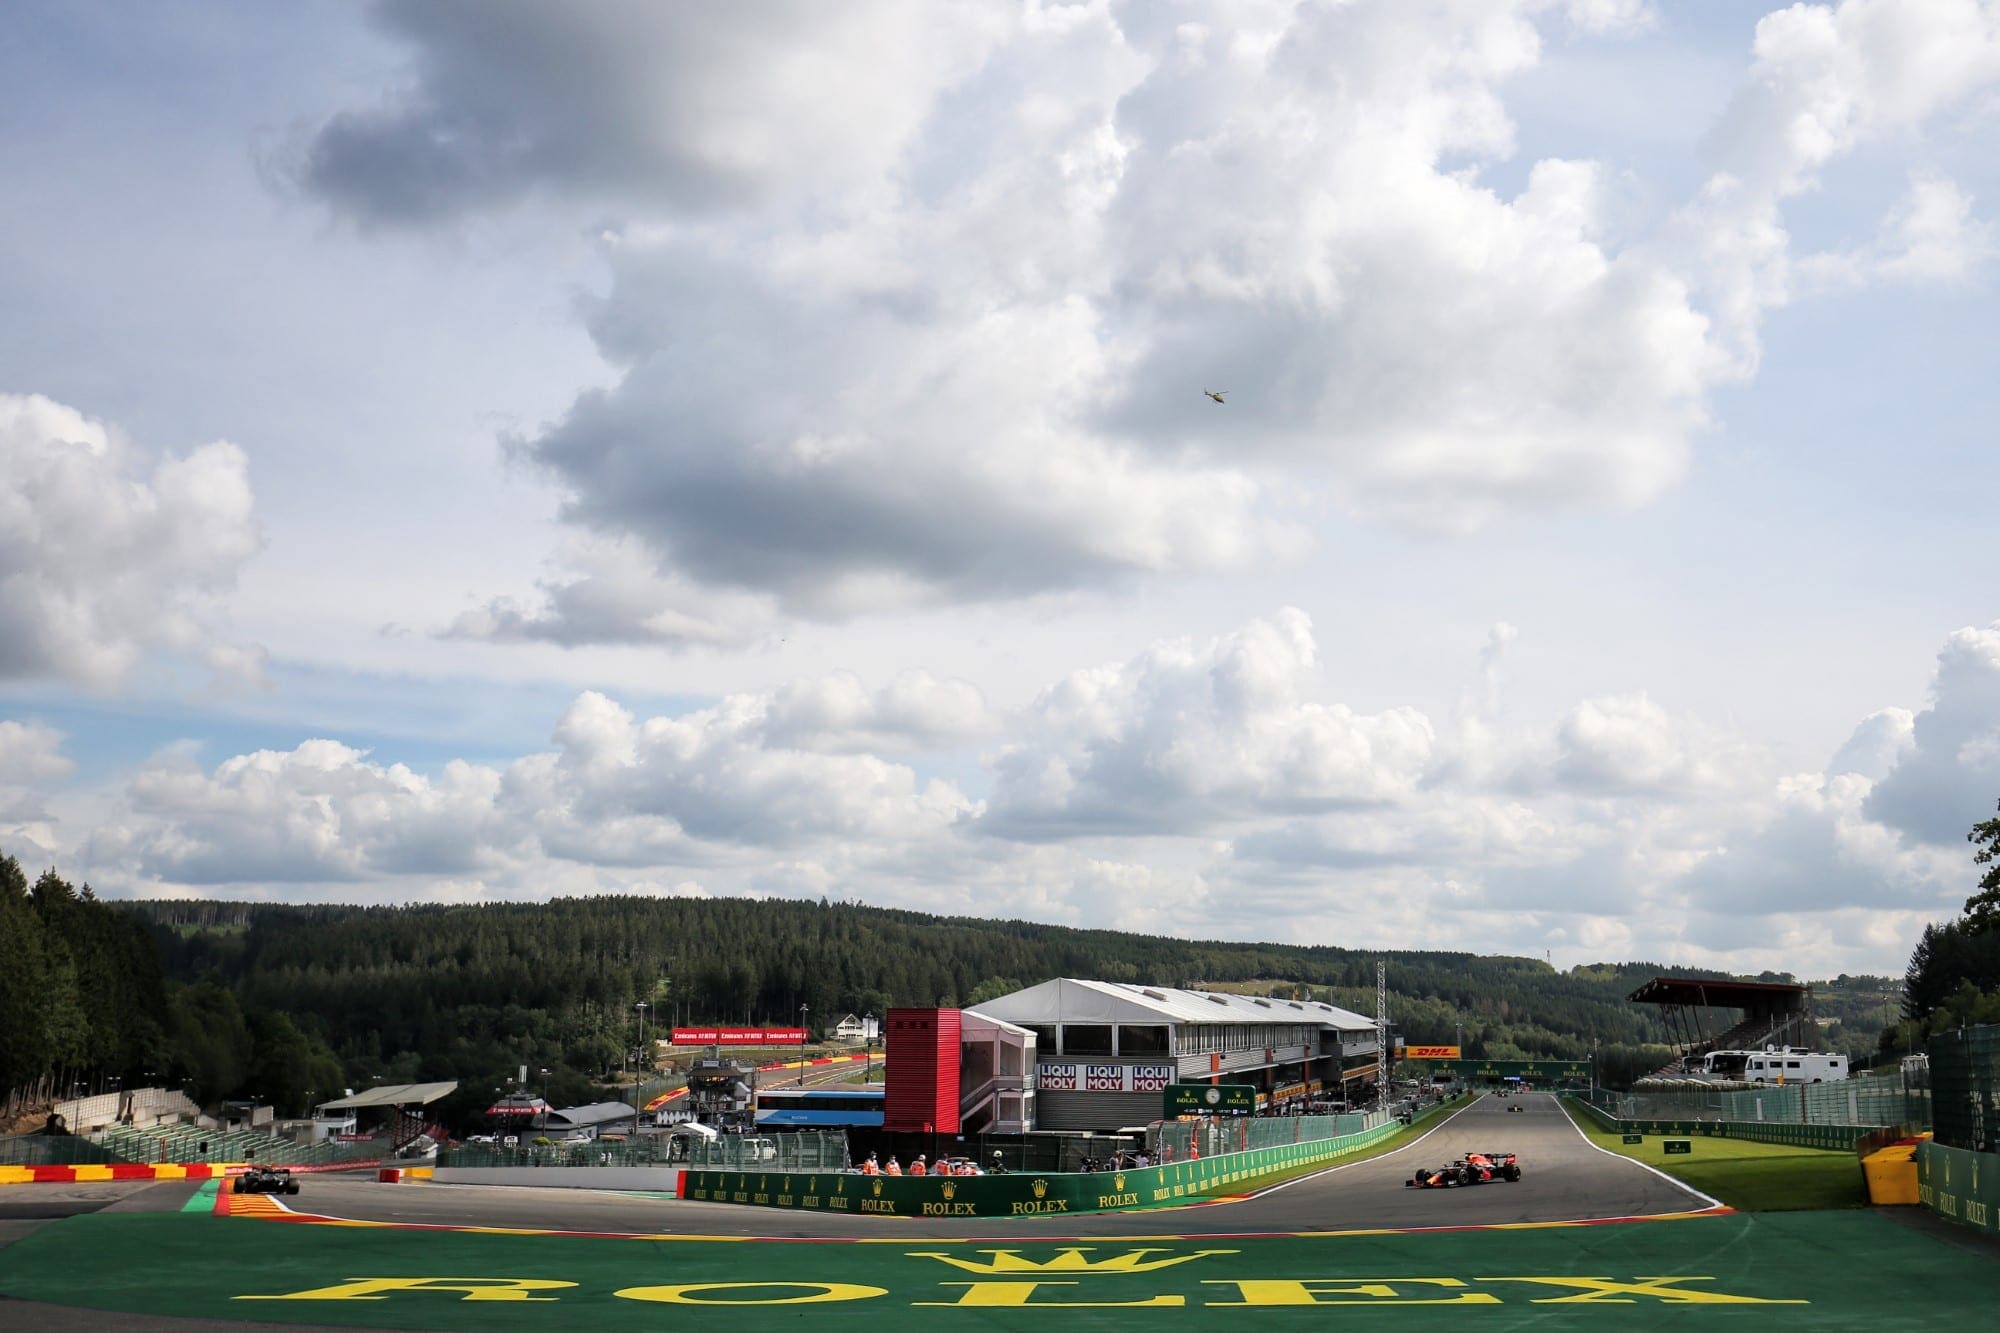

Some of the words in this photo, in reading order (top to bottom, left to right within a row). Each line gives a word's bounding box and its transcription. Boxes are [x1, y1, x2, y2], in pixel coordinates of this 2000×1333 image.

[1416, 1048, 1452, 1056] DHL
[1041, 1065, 1075, 1077] LIQUI
[1087, 1066, 1121, 1078] LIQUI
[1134, 1067, 1168, 1078] LIQUI
[1041, 1077, 1076, 1089] MOLY
[1087, 1078, 1122, 1090] MOLY
[829, 1196, 848, 1209] ROLEX
[861, 1199, 896, 1213] ROLEX
[1098, 1192, 1139, 1208] ROLEX
[922, 1202, 976, 1215] ROLEX
[1011, 1199, 1069, 1215] ROLEX
[1966, 1199, 1987, 1226] ROLEX
[230, 1275, 1811, 1307] ROLEX
